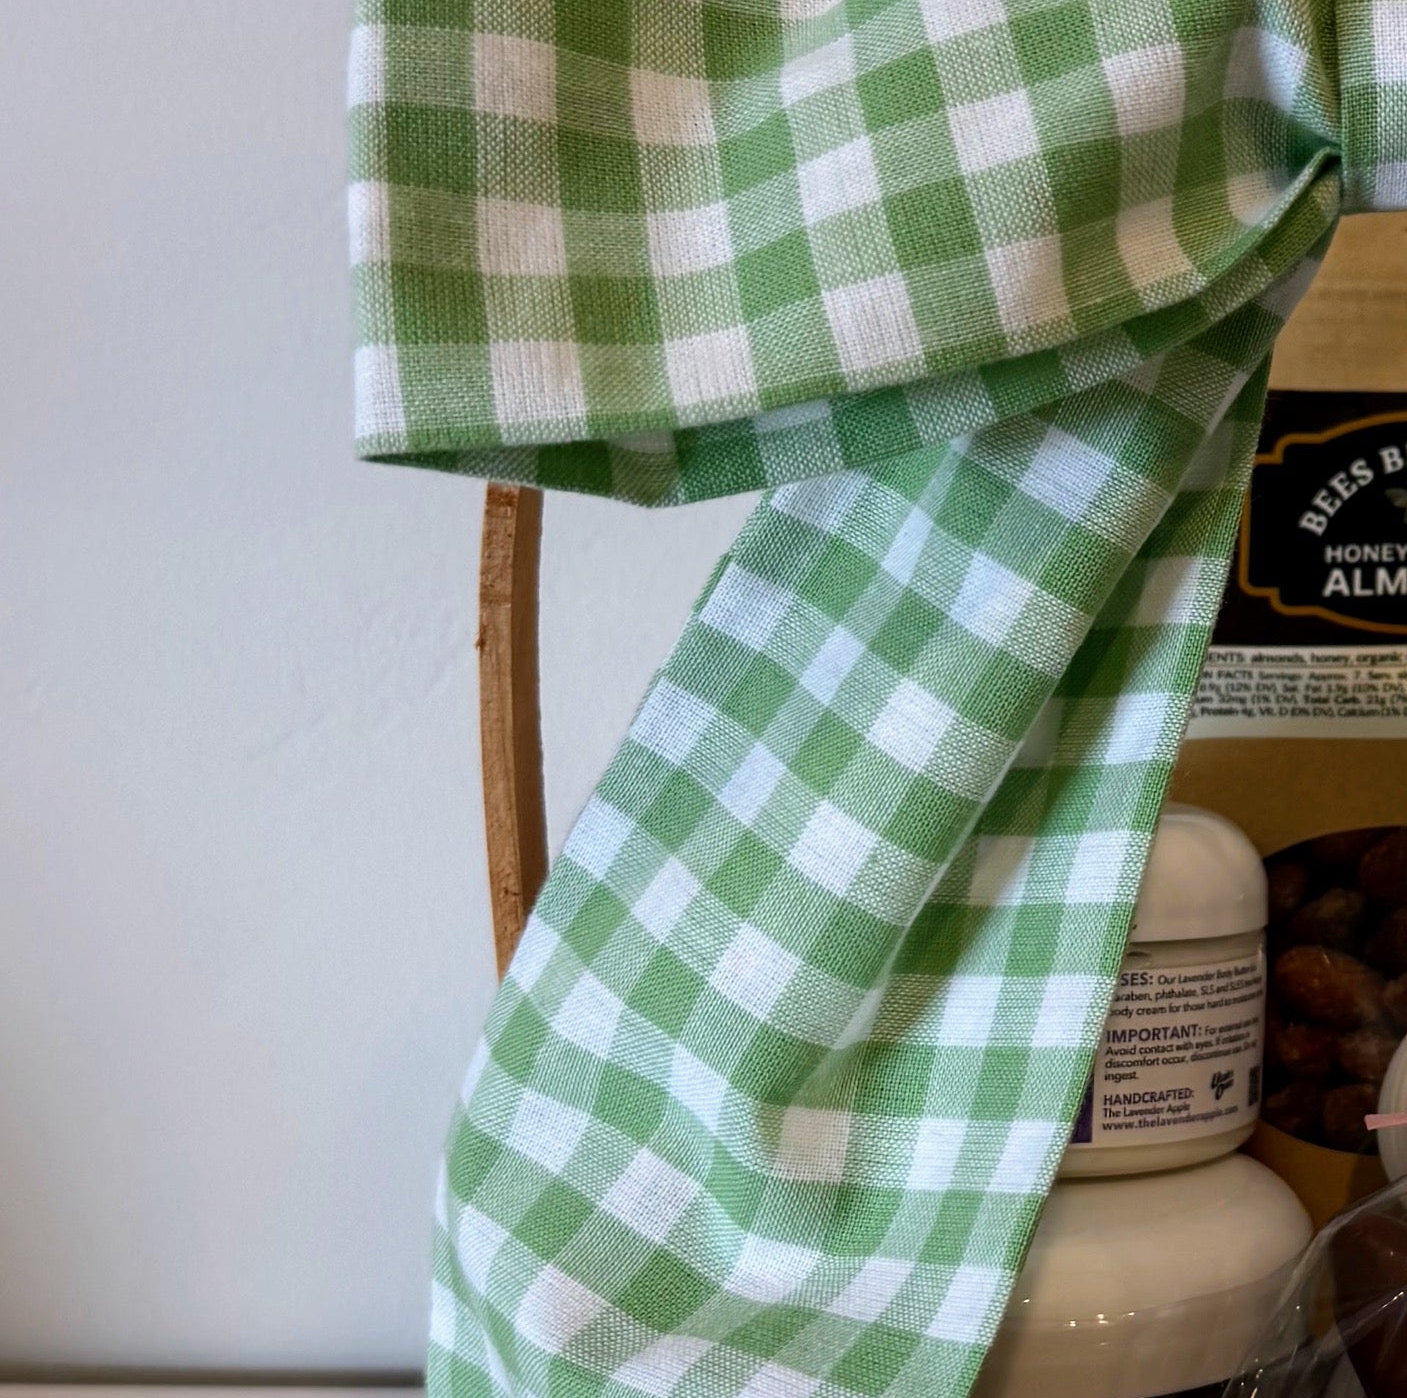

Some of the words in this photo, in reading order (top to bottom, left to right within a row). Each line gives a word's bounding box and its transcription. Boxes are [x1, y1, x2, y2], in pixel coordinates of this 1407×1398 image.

[1298, 457, 1375, 536] BEES
[1120, 971, 1154, 987] SES:
[1157, 974, 1176, 986] Our
[1178, 970, 1216, 984] Lavender
[1112, 990, 1153, 1003] araben,
[1136, 1004, 1167, 1016] cream
[1169, 1001, 1182, 1014] for
[1183, 999, 1206, 1012] those
[1106, 1023, 1202, 1043] IMPORTANT:
[1205, 1025, 1217, 1036] For
[1105, 1046, 1136, 1057] Avoid
[1139, 1043, 1173, 1055] contact
[1176, 1041, 1194, 1052] with
[1105, 1056, 1159, 1069] discomfort
[1104, 1070, 1139, 1083] ingest.
[1103, 1087, 1195, 1106] HANDCRAFTED:
[1103, 1107, 1121, 1118] The
[1123, 1103, 1165, 1117] Lavender
[1166, 1102, 1190, 1114] Apple
